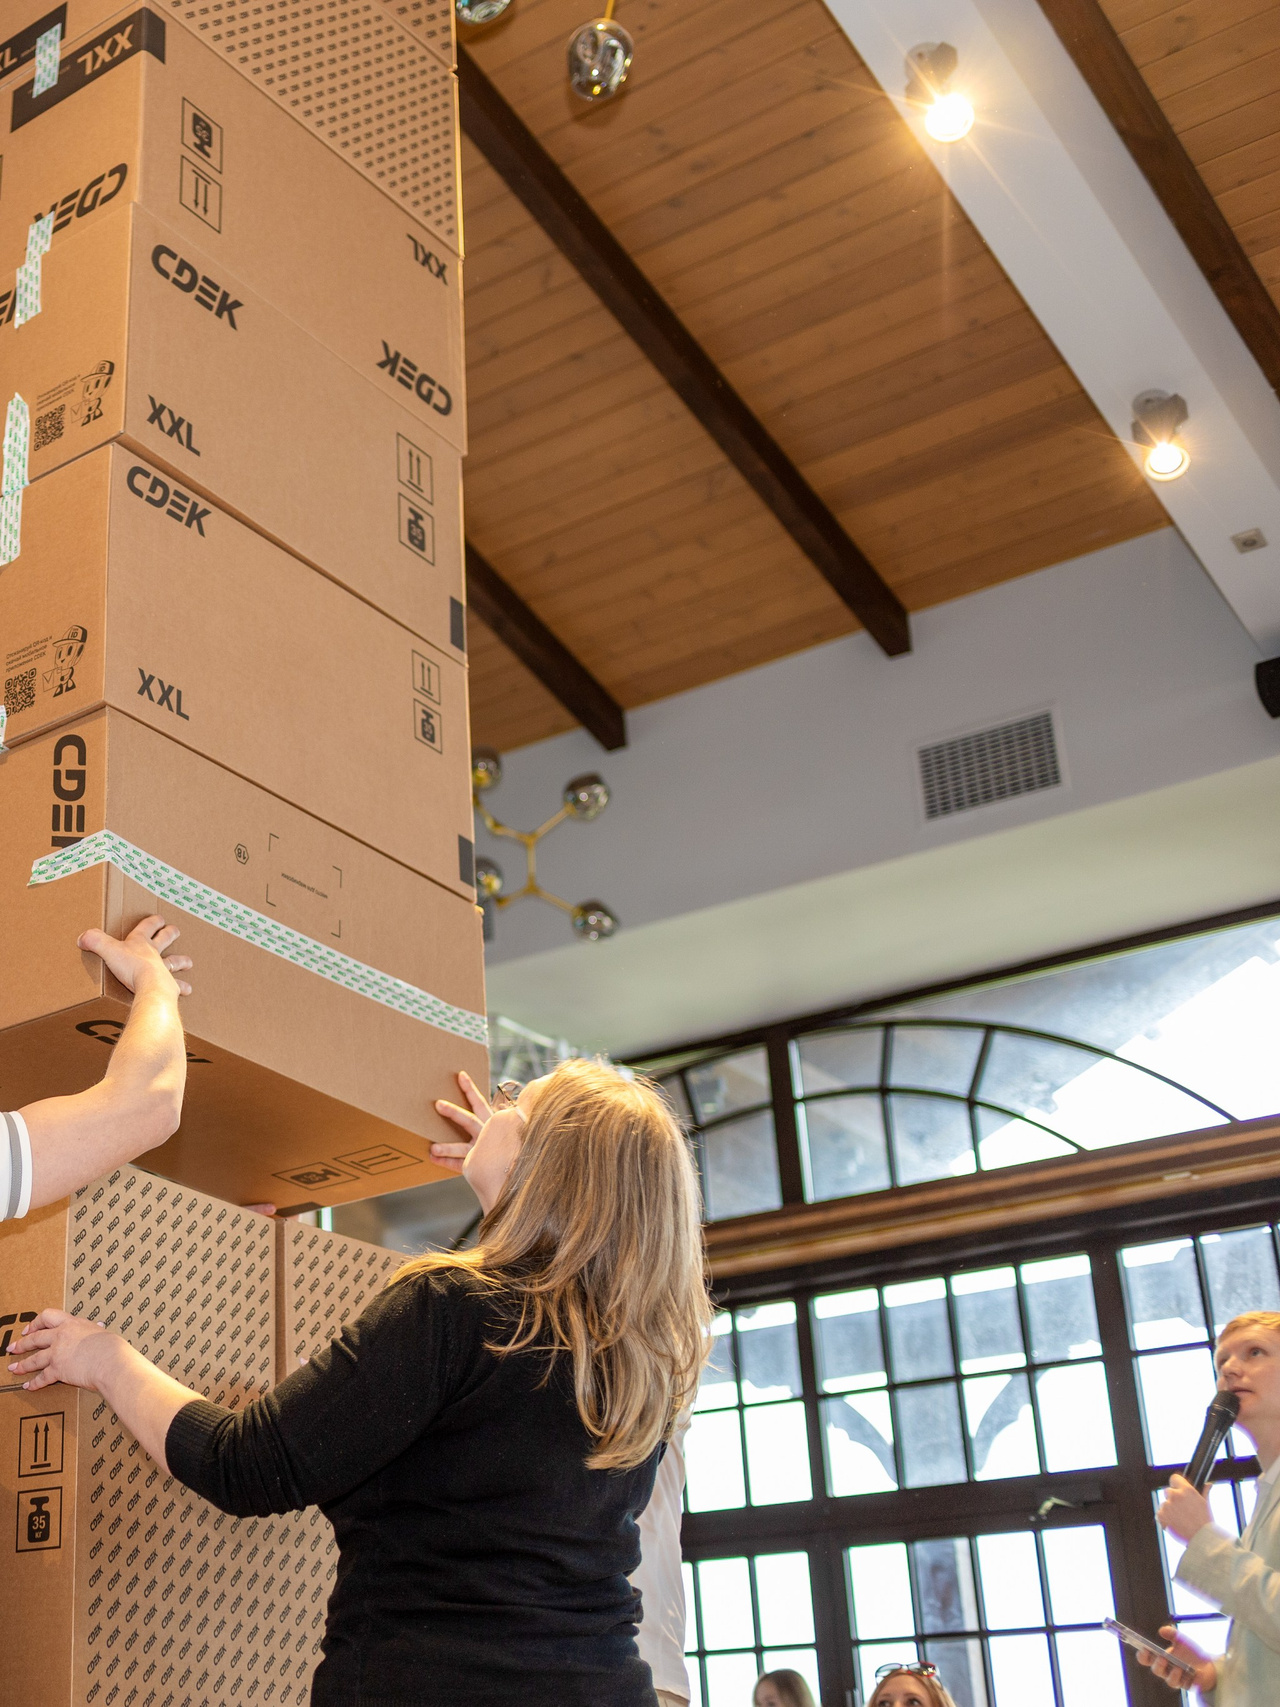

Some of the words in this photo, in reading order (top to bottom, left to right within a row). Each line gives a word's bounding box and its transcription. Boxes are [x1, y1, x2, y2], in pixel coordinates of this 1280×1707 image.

[77, 24, 134, 76] XXL
[34, 163, 128, 235] CDE
[406, 233, 448, 286] XXL
[151, 244, 244, 331] CDEK
[376, 339, 453, 416] CDEK
[147, 394, 201, 457] XXL
[126, 465, 212, 538] CDEK
[137, 667, 190, 721] XXL
[237, 848, 246, 860] 18
[91, 1426, 107, 1449] CDEK
[90, 1454, 106, 1477] CDEK
[127, 1462, 142, 1485] CDEK
[144, 1466, 160, 1489] CDEK
[108, 1485, 124, 1508] CDEK
[126, 1489, 142, 1513] CDEK
[162, 1498, 177, 1520] CDEK
[179, 1502, 194, 1524] CDEK
[32, 1515, 46, 1530] 35
[108, 1513, 124, 1536] CDEK
[126, 1517, 142, 1540] CDEK
[161, 1524, 177, 1547] CDEK
[179, 1528, 194, 1551] CDEK
[213, 1535, 227, 1558] CDEK
[89, 1537, 105, 1560] CDEK
[143, 1548, 159, 1571] CDEK
[230, 1539, 244, 1561] CDEK
[246, 1542, 260, 1565] CDEK
[262, 1546, 276, 1568] CDEK
[161, 1551, 176, 1575] CDEK
[196, 1559, 211, 1581] CDEK
[213, 1562, 227, 1585] CDEK
[294, 1554, 307, 1575] CDEK
[107, 1568, 122, 1592] CDEK
[125, 1572, 141, 1596] CDEK
[230, 1565, 244, 1588] CDEK
[262, 1572, 276, 1595] CDEK
[278, 1576, 292, 1598] CDEK
[161, 1579, 176, 1602] CDEK
[178, 1582, 193, 1605] CDEK
[196, 1586, 211, 1609] CDEK
[87, 1593, 104, 1617] CDEK
[125, 1599, 140, 1624] CDEK
[143, 1603, 158, 1627] CDEK
[230, 1592, 244, 1615] CDEK
[246, 1595, 260, 1618] CDEK
[279, 1602, 292, 1624] CDEK
[178, 1609, 193, 1633] CDEK
[213, 1616, 227, 1639] CDEK
[295, 1605, 308, 1627] CDEK
[106, 1625, 122, 1649] CDEK
[124, 1627, 140, 1652] CDEK
[230, 1619, 244, 1642] CDEK
[246, 1622, 260, 1645] CDEK
[279, 1628, 293, 1650] CDEK
[160, 1634, 176, 1658] CDEK
[195, 1640, 210, 1664] CDEK
[295, 1632, 308, 1653] CDEK
[86, 1650, 103, 1675] CDEK
[105, 1653, 121, 1678] CDEK
[213, 1643, 227, 1666] CDEK
[246, 1649, 261, 1672] CDEK
[279, 1654, 293, 1677] CDEK
[142, 1659, 158, 1684] CDEK
[160, 1662, 175, 1686] CDEK
[195, 1667, 210, 1692] CDEK
[213, 1670, 227, 1694] CDEK
